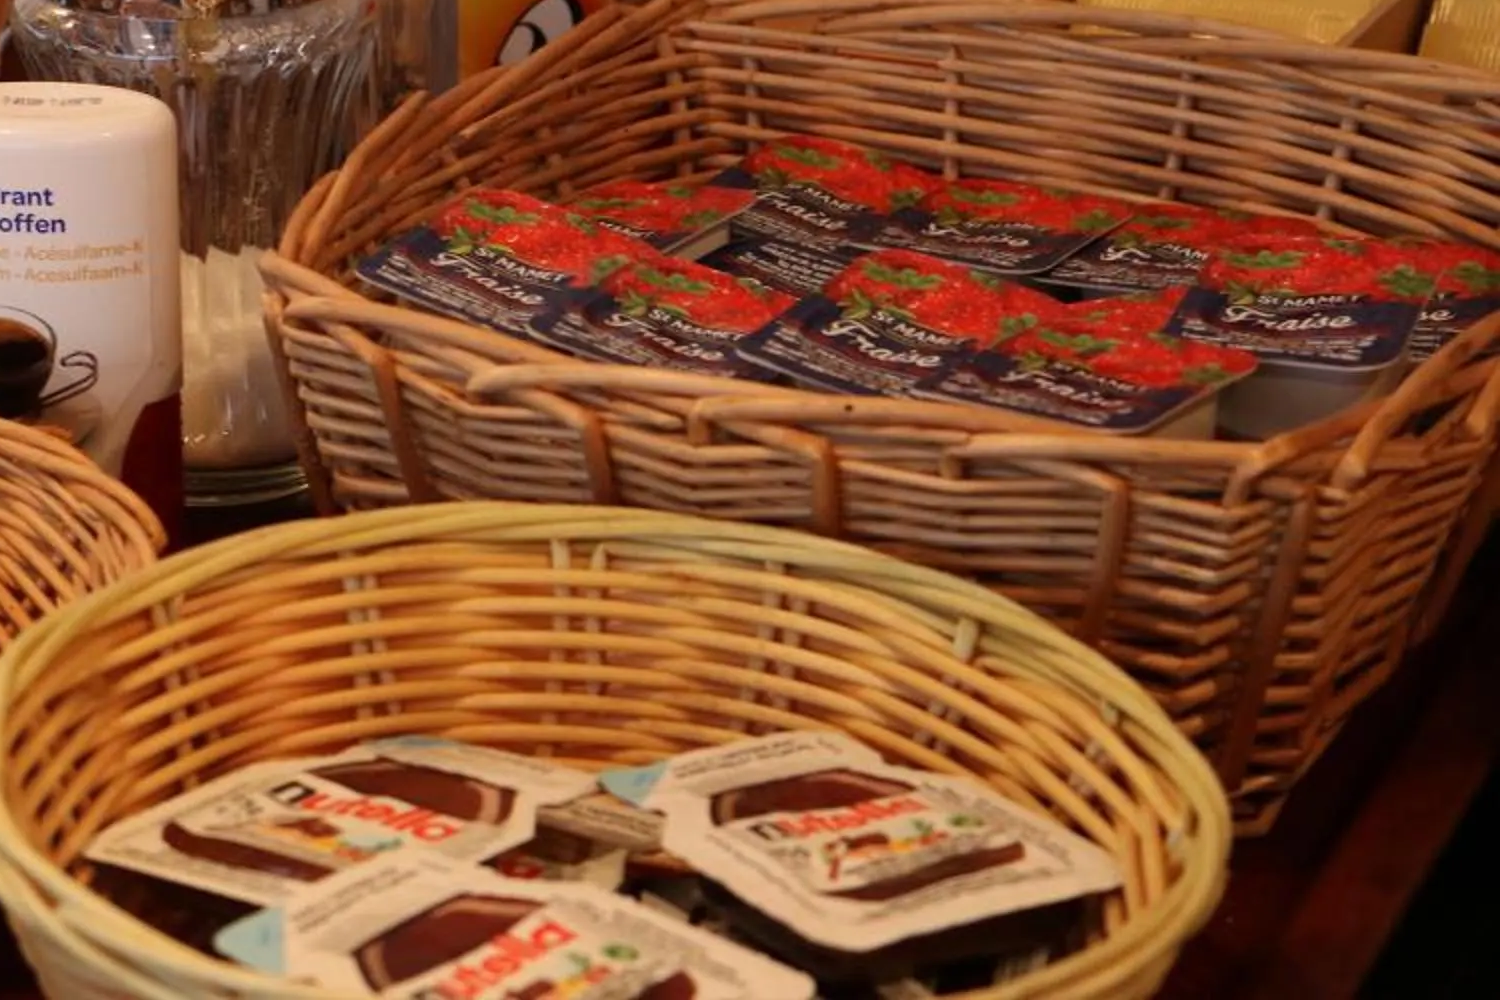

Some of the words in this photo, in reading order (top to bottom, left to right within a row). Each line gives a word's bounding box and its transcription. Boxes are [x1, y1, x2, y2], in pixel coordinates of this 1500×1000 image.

[429, 251, 545, 305] Fraise
[604, 312, 725, 362] Fraise
[821, 318, 943, 368] Fraise
[1220, 306, 1357, 331] Fraise
[269, 781, 461, 843] nutella
